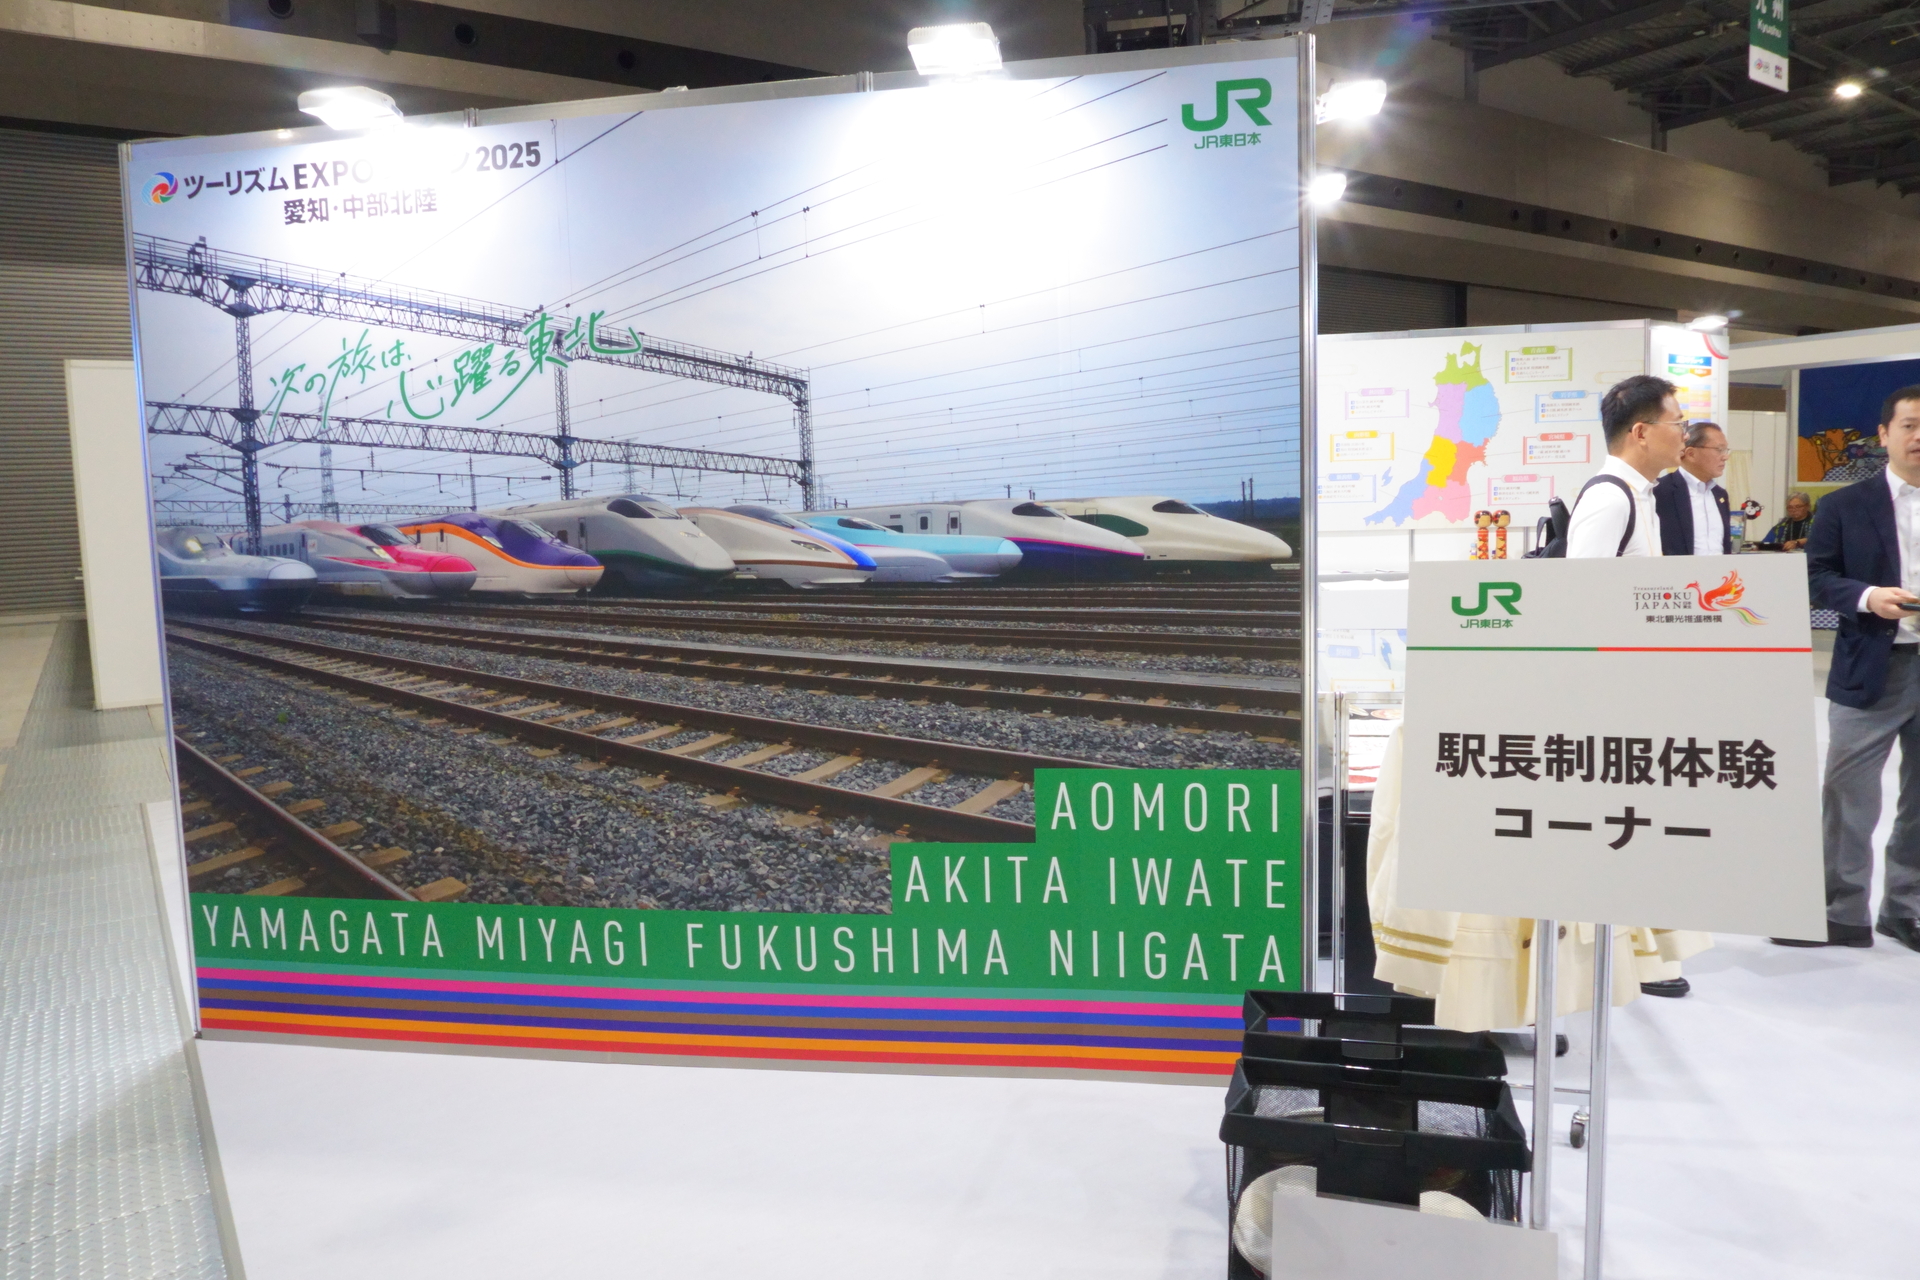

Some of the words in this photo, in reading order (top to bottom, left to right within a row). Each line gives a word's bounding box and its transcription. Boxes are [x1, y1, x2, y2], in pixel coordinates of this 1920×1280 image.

[1181, 77, 1273, 132] JR
[1194, 132, 1262, 149] JR東日本
[1451, 581, 1522, 616] JR
[1633, 592, 1692, 601] TOHOKU
[1635, 601, 1682, 611] JAPAN
[1460, 618, 1513, 629] JR東日本
[1645, 614, 1723, 624] 東北観光推進機構
[1436, 732, 1778, 790] 駅長制服体験
[1051, 781, 1279, 833] AOMORI
[1495, 806, 1711, 850] コーナー
[905, 856, 1069, 904] AKITA
[1110, 857, 1286, 909] IWATE
[202, 904, 444, 957] YAMAGATA
[476, 915, 648, 967] MIYAGI
[686, 923, 1009, 976] FUKUSHIMA
[1050, 930, 1286, 983] NIIGATA
